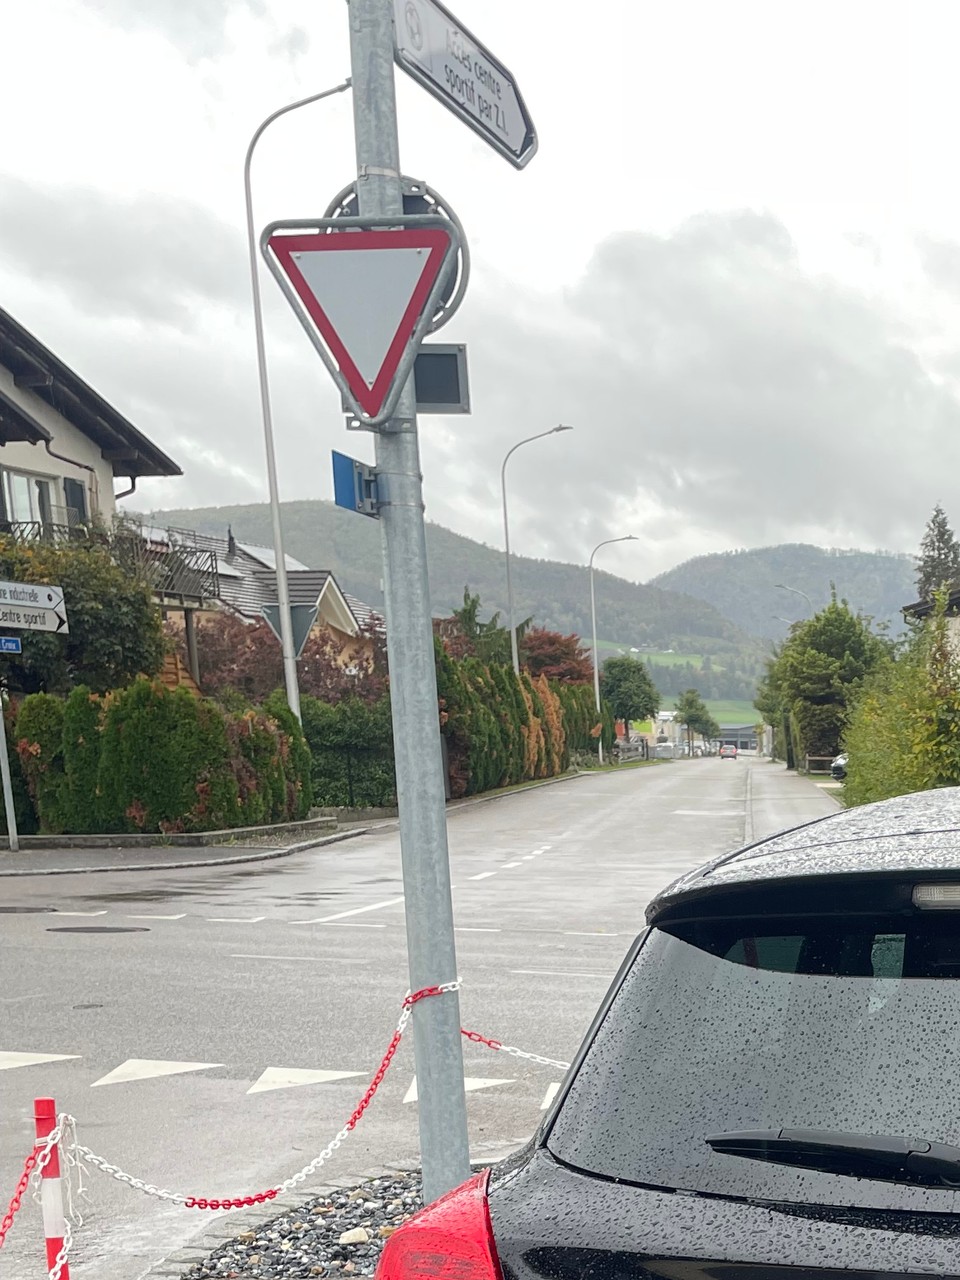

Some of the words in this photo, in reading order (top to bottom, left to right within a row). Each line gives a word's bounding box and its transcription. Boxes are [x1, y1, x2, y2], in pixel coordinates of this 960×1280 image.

[445, 64, 475, 106] sportif
[478, 94, 492, 121] par
[474, 62, 502, 100] centre
[23, 612, 46, 627] sportif
